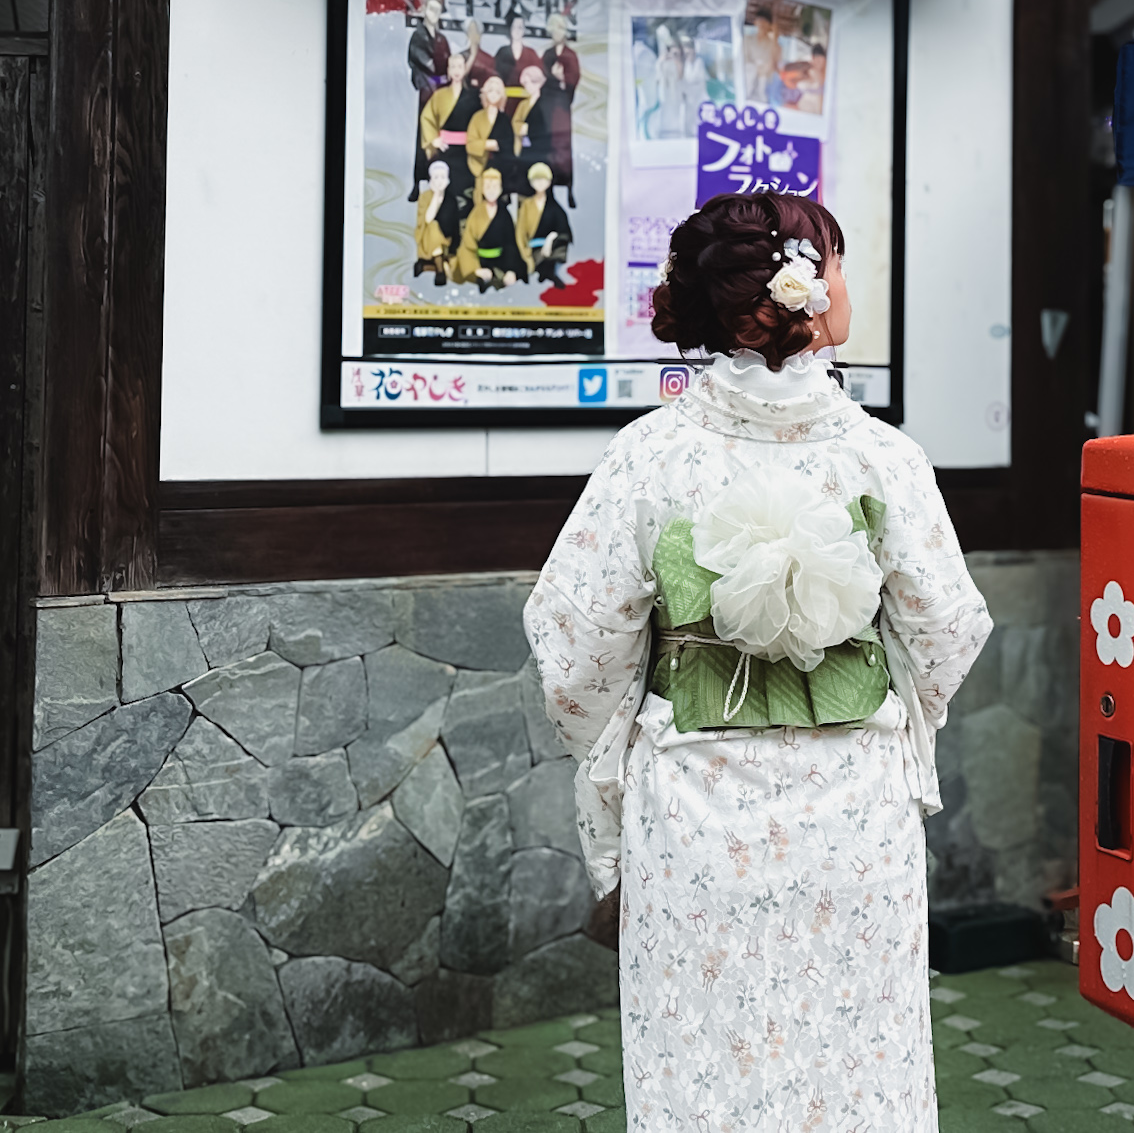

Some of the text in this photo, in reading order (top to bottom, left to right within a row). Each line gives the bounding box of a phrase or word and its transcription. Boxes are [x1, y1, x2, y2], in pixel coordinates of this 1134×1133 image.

[702, 131, 772, 172] フォト
[371, 367, 466, 401] 花やしき
